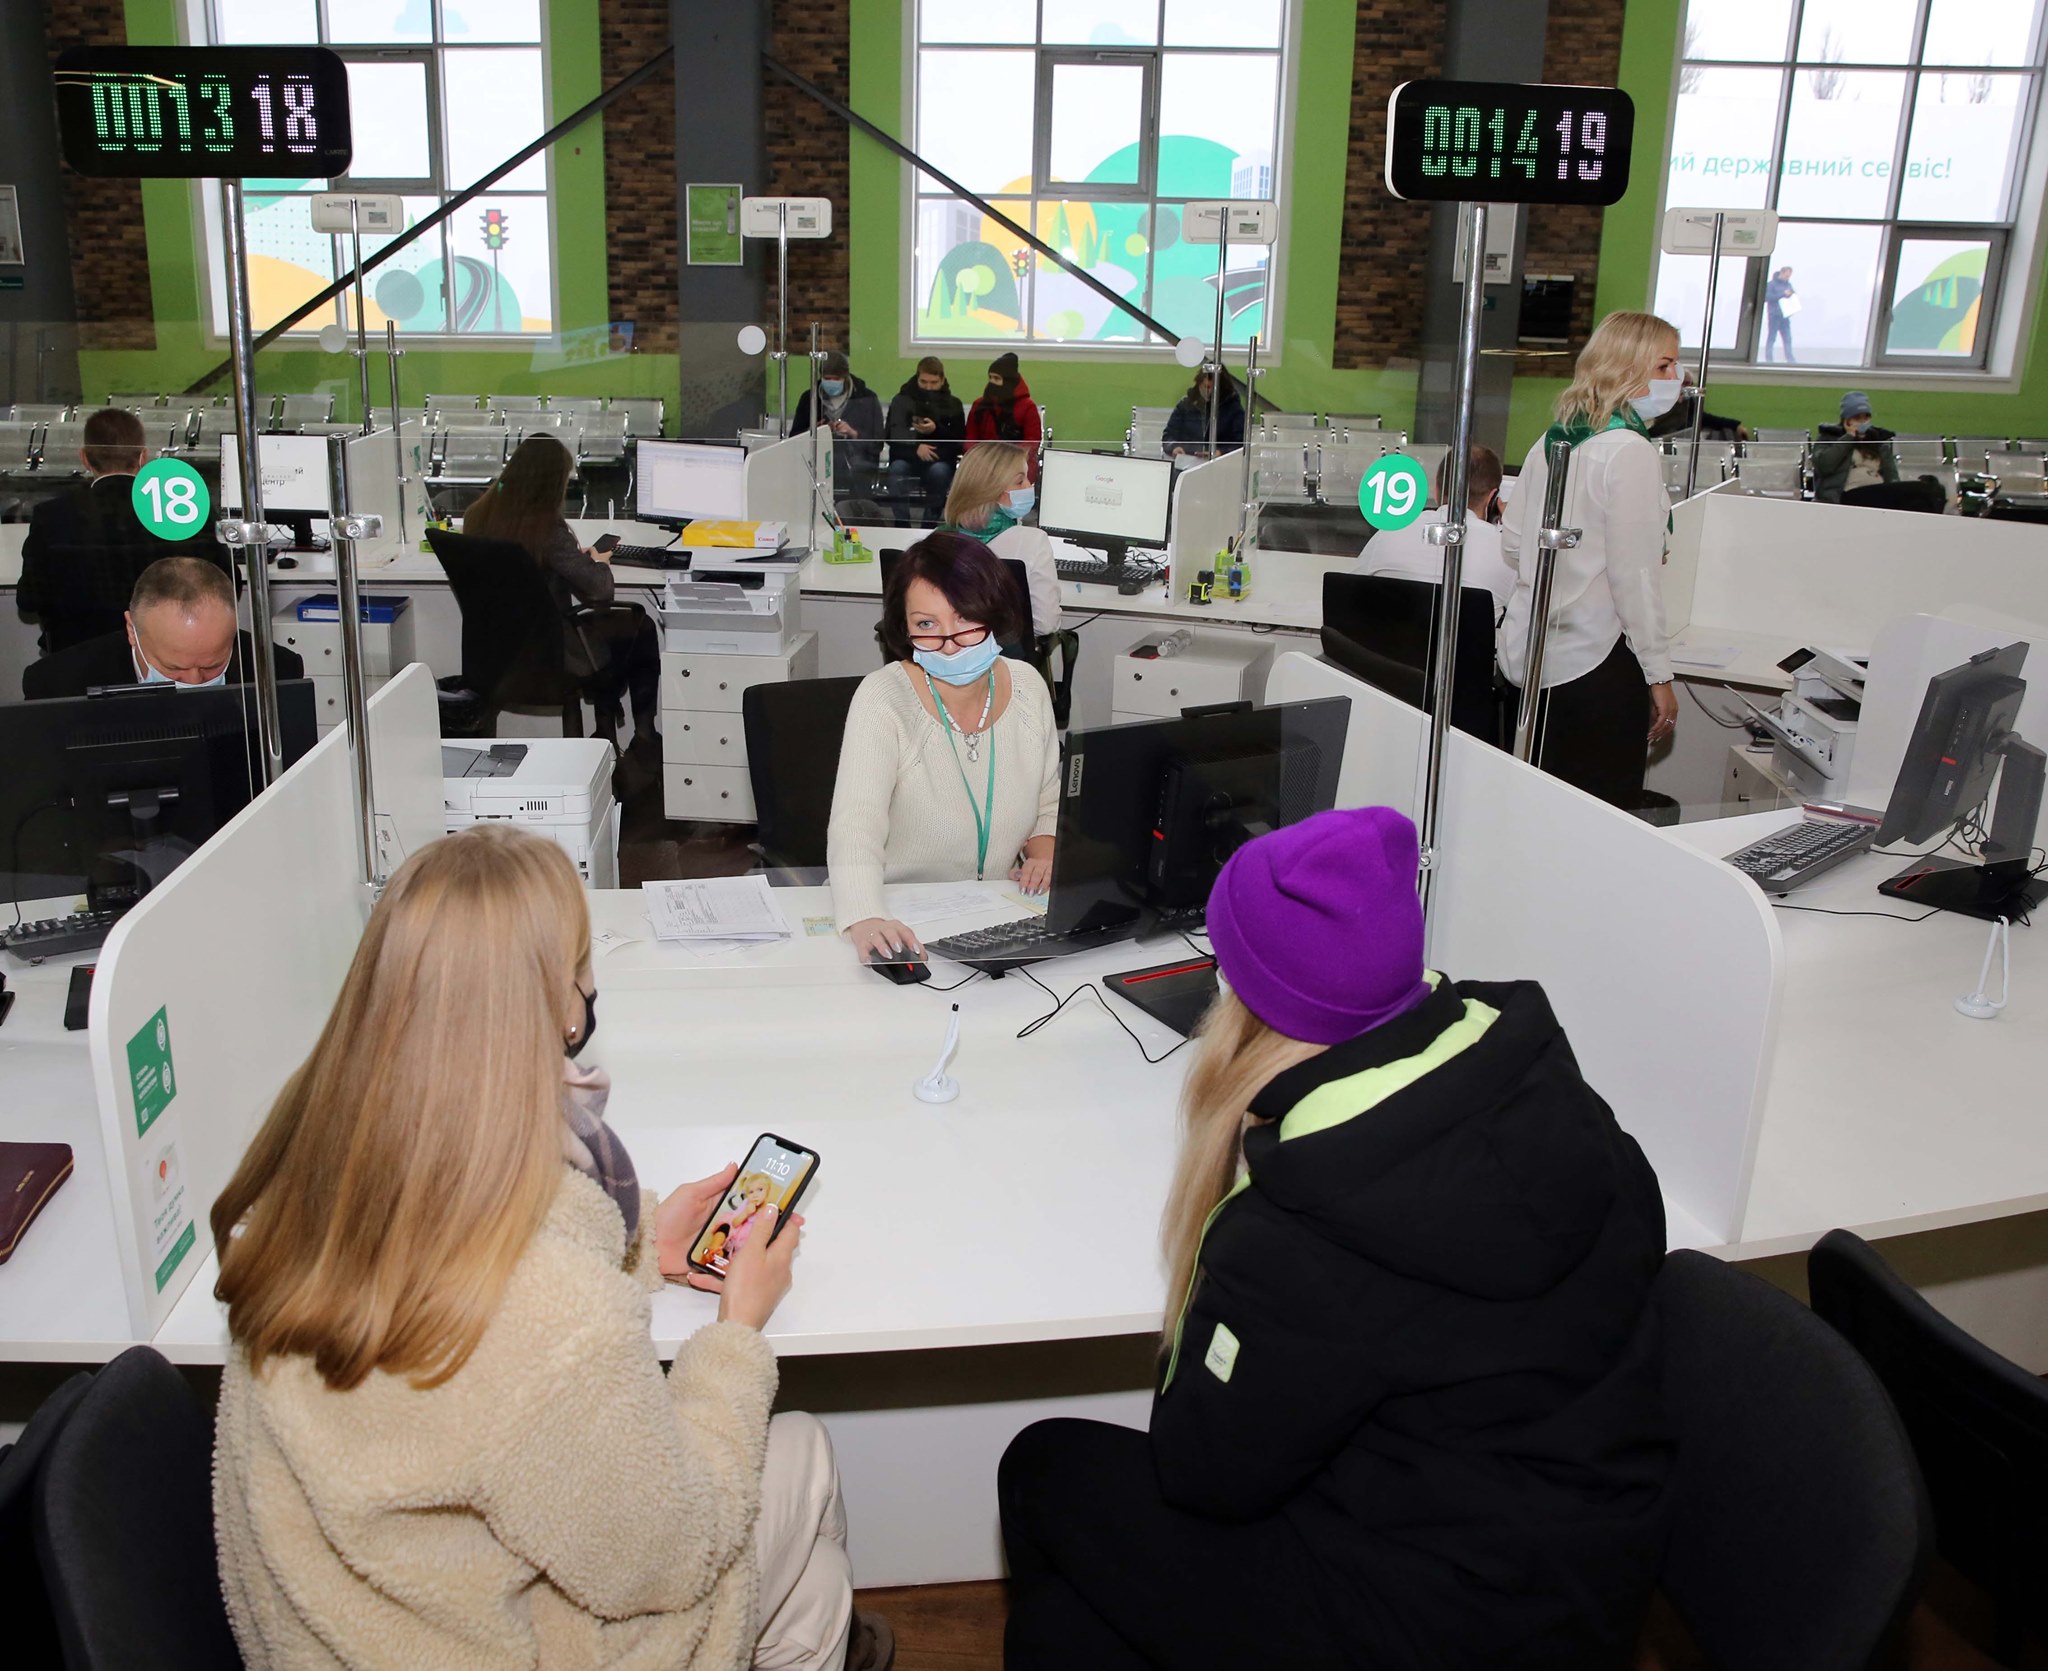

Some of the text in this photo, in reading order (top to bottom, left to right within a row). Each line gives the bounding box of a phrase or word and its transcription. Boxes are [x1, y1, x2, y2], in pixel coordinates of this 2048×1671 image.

[251, 75, 318, 153] 18
[1556, 111, 1607, 180] 19
[1703, 156, 1853, 179] держвний
[1861, 157, 1952, 179] севіс!
[141, 476, 199, 524] 18
[1367, 471, 1416, 516] 19
[1070, 757, 1081, 794] Lenovo
[765, 1157, 791, 1176] 11:10
